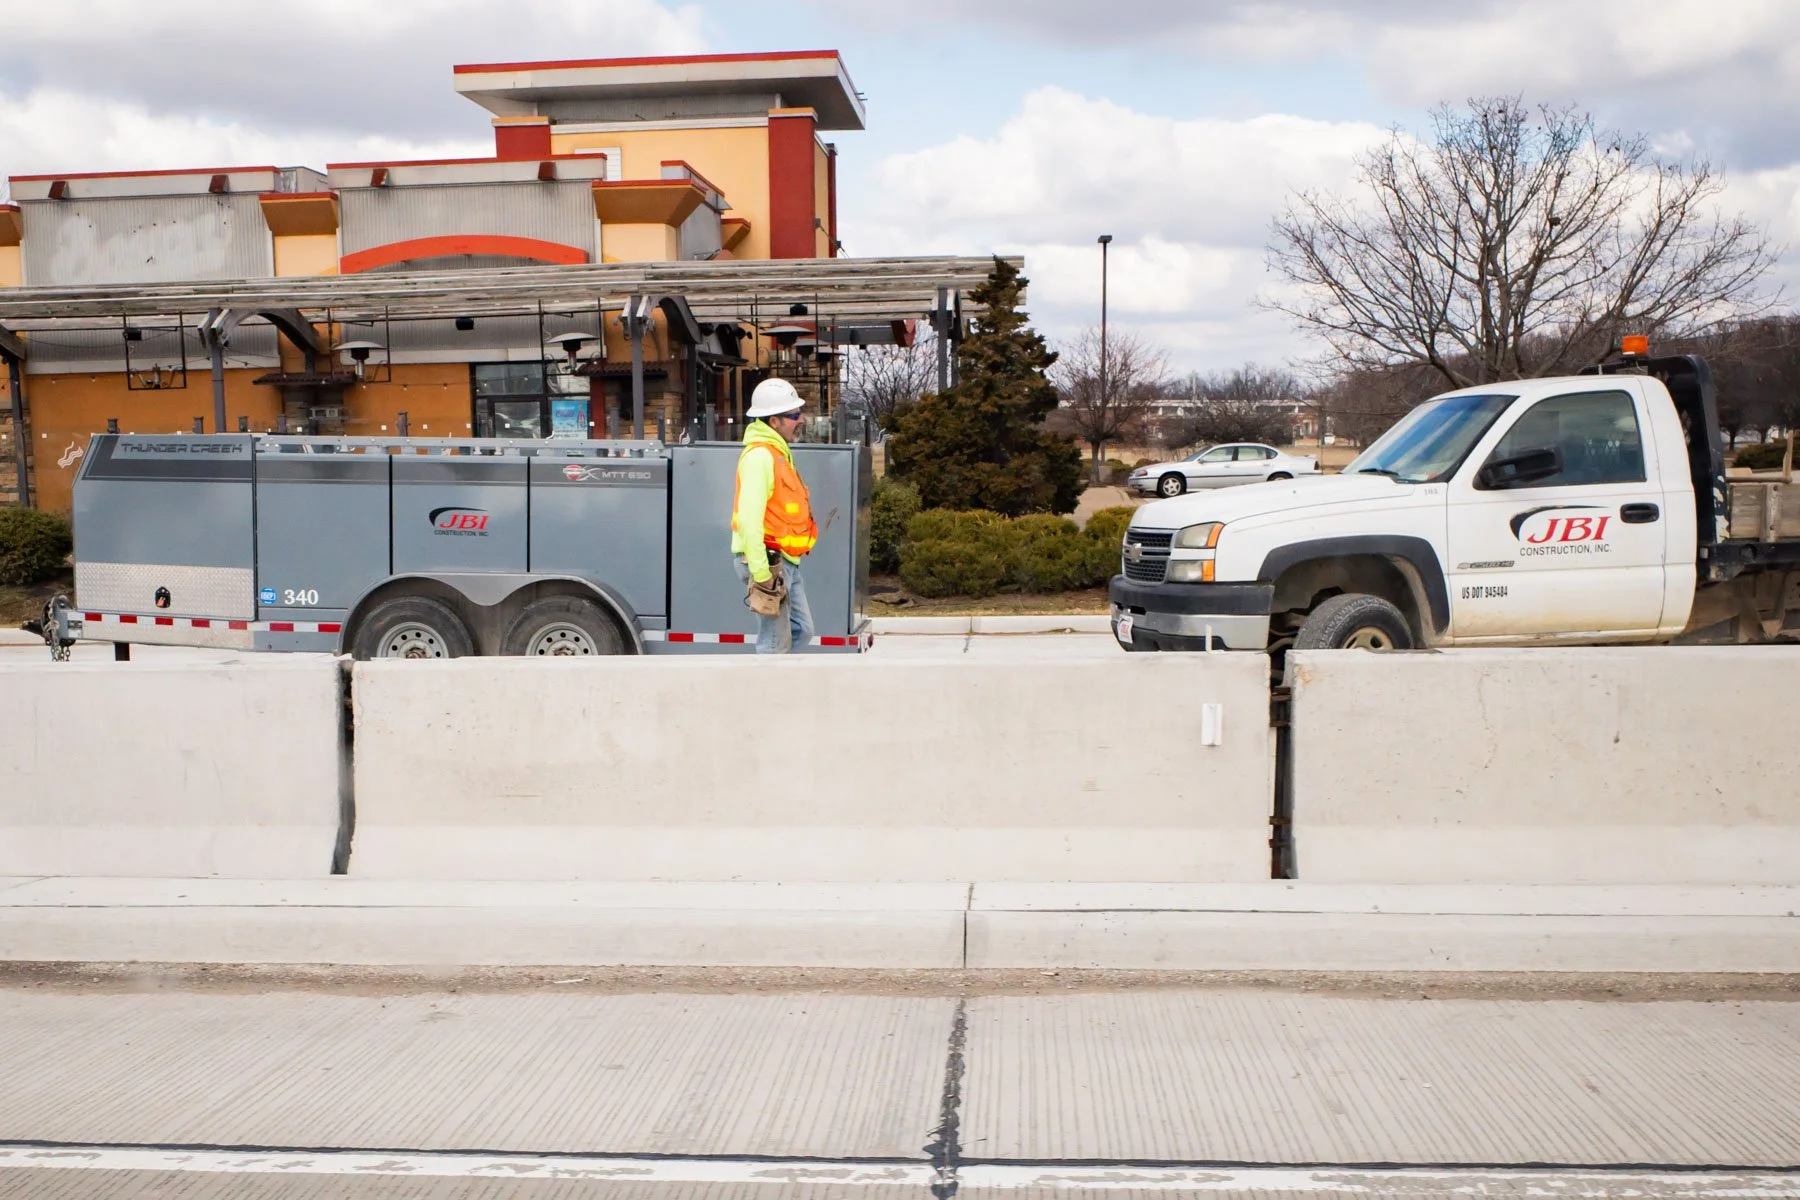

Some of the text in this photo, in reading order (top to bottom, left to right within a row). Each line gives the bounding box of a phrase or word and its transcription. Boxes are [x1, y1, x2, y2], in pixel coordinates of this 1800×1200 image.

[121, 443, 243, 454] THUNDER CREEK
[601, 471, 626, 479] MTT
[438, 513, 489, 530] JBI
[1526, 515, 1612, 544] JBI
[1519, 543, 1612, 557] CONSTRUCTION, INC.
[284, 589, 319, 606] 340
[1461, 587, 1470, 600] US
[1471, 586, 1483, 599] DOT
